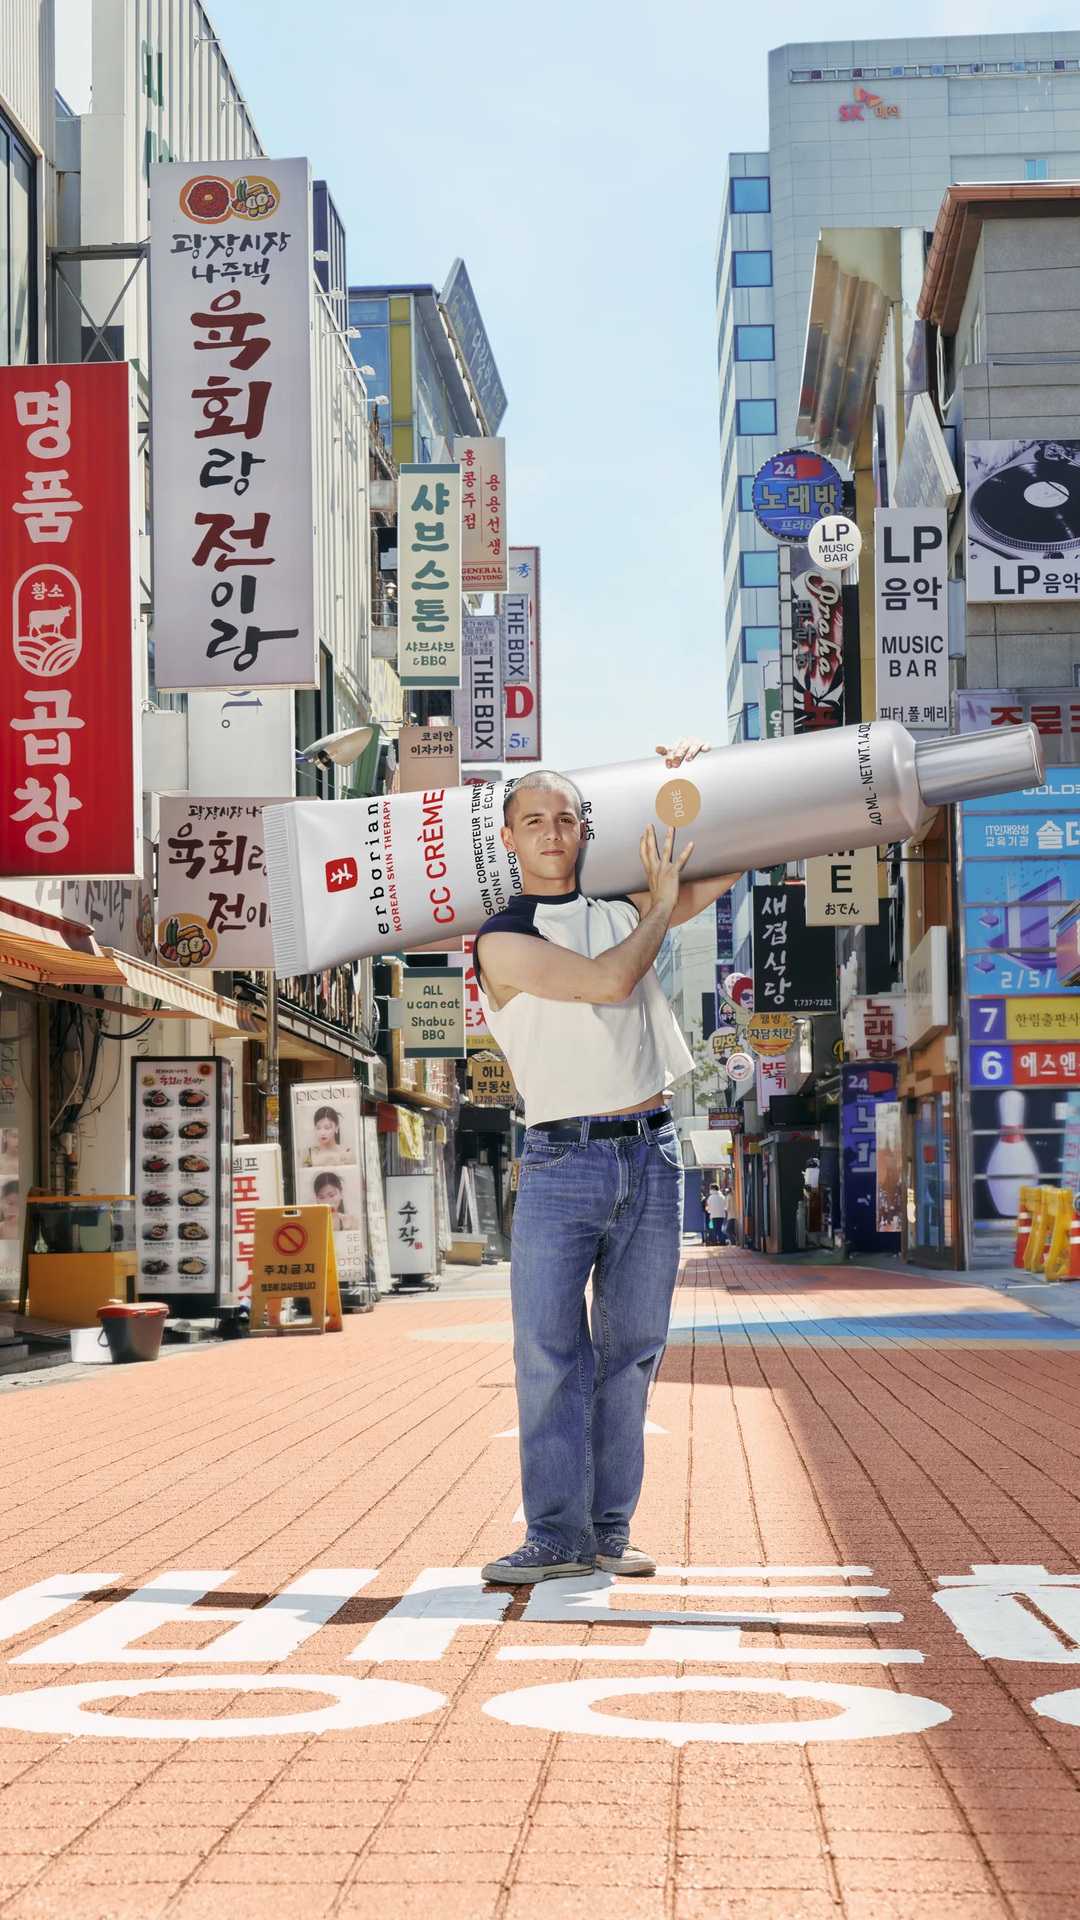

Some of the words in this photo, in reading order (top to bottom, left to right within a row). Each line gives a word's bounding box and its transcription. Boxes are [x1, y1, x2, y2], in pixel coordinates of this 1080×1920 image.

[839, 104, 864, 121] SK
[170, 231, 291, 259] 광장시장
[192, 258, 271, 285] 나주댁
[12, 380, 83, 543] 명품
[774, 462, 795, 477] 24
[460, 449, 476, 530] 홍콩주점
[758, 483, 838, 518] 노래방
[485, 474, 501, 556] 용용선생
[822, 524, 850, 542] LP
[819, 543, 854, 553] MUSIC
[883, 526, 943, 563] LP
[411, 483, 450, 632] 샤브스톤
[824, 554, 848, 563] BAR
[31, 582, 65, 601] 황소
[881, 577, 942, 611] 음악
[507, 599, 525, 634] THE
[805, 571, 843, 676] Praha
[405, 641, 455, 653] 샤브샤브
[882, 635, 944, 655] MUSIC
[412, 655, 447, 667] &BBQ
[508, 639, 525, 676] BOX
[473, 656, 494, 699] THE
[889, 660, 938, 677] BAR
[421, 731, 454, 742] 코리안
[474, 705, 495, 750] BOX
[411, 744, 454, 756] 이자카야
[508, 733, 529, 748] 5F
[9, 690, 86, 854] 곱창
[472, 782, 484, 813] TEINTÉ
[482, 781, 496, 810] ÉCLAT
[669, 788, 685, 818] DORÉ
[865, 792, 879, 810] ML
[188, 805, 243, 820] 광장시장
[581, 801, 592, 815] 30
[869, 811, 882, 825] 40
[383, 800, 392, 850] THERAPY
[484, 815, 494, 829] ET
[585, 818, 595, 841] SPF
[985, 825, 1029, 836] IT인재양성
[417, 789, 447, 881] CRÈME
[985, 836, 1029, 848] 교육기관
[472, 817, 487, 885] CORRECTEUR
[485, 834, 497, 864] MINE
[365, 802, 391, 935] erborian
[385, 853, 395, 881] SKIN
[386, 884, 402, 932] KOREAN
[430, 886, 455, 924] CC
[482, 888, 496, 916] SOIN
[825, 903, 860, 915] おでん
[207, 891, 271, 934] 전이
[762, 894, 792, 1005] 새겹식당
[423, 985, 443, 996] ALL
[416, 1001, 438, 1009] can
[441, 998, 460, 1009] eat
[794, 998, 832, 1007] T.737-7282
[411, 1016, 447, 1027] Shabu
[760, 1013, 780, 1025] 웰빙
[863, 999, 895, 1059] 노래방
[979, 1007, 998, 1033] 7
[1015, 1012, 1080, 1029] 한림출판사
[422, 1030, 446, 1040] BBQ
[482, 1066, 504, 1079] 하나
[981, 1051, 1003, 1080] 6
[1020, 1052, 1080, 1078] 에스앤
[477, 1081, 511, 1094] 부동산
[848, 1075, 869, 1091] 24
[474, 1095, 514, 1104] T.720-3335
[398, 1201, 419, 1247] 수작
[346, 1233, 360, 1242] SE
[347, 1245, 360, 1254] LF
[338, 1257, 361, 1267] OTO
[338, 1269, 362, 1278] OTH
